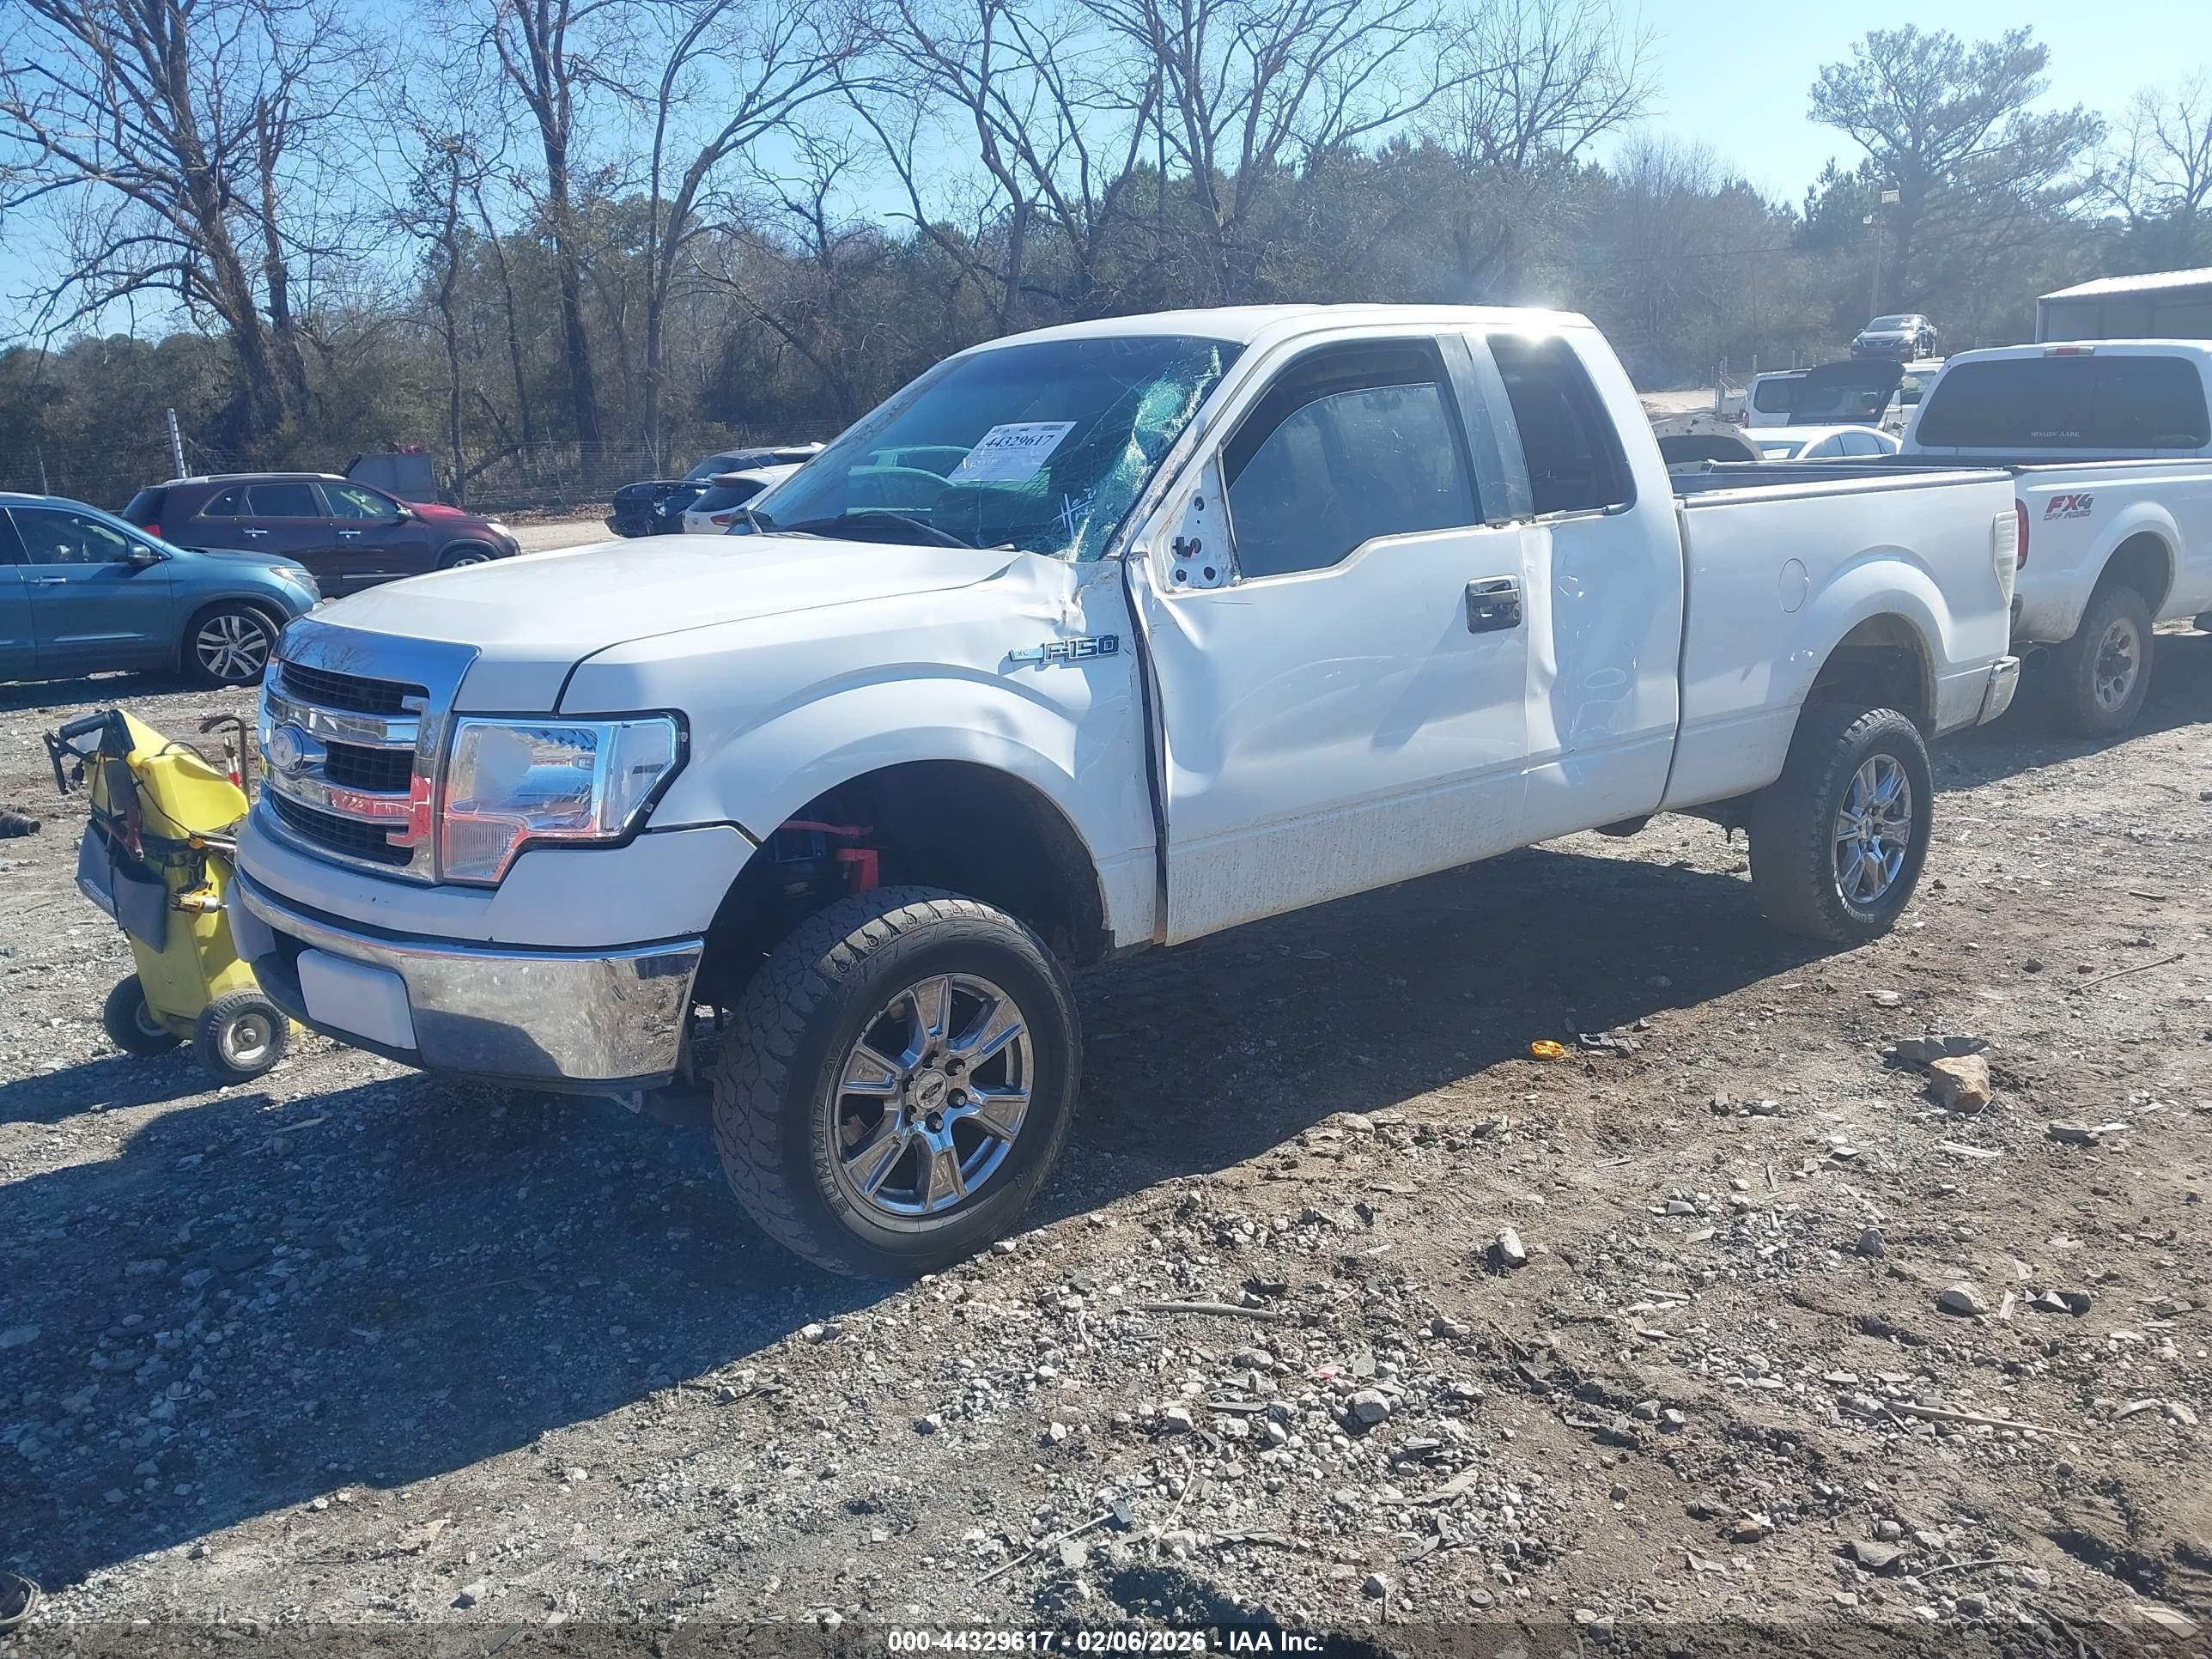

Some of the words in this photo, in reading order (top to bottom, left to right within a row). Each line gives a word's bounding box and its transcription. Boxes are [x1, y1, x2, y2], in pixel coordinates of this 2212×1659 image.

[985, 434, 1055, 447] 44329617
[2045, 494, 2094, 513] FX4
[2064, 510, 2092, 519] ROAD
[1044, 634, 1119, 664] F-150
[811, 1097, 850, 1216] SUMMIT
